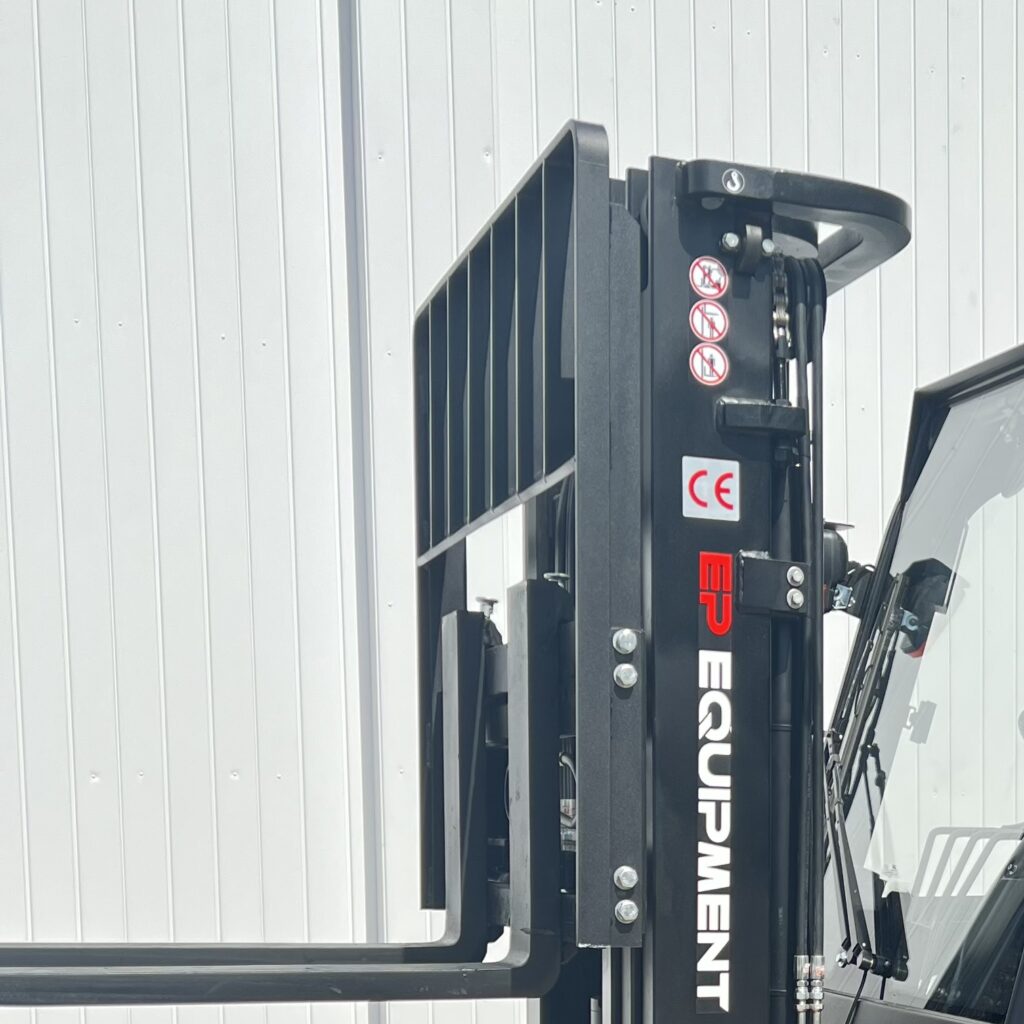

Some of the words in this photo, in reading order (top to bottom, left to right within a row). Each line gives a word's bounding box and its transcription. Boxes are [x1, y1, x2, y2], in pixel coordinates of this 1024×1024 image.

[688, 470, 734, 511] CE
[699, 551, 734, 636] EP
[697, 649, 732, 1013] EQUIPMENT
